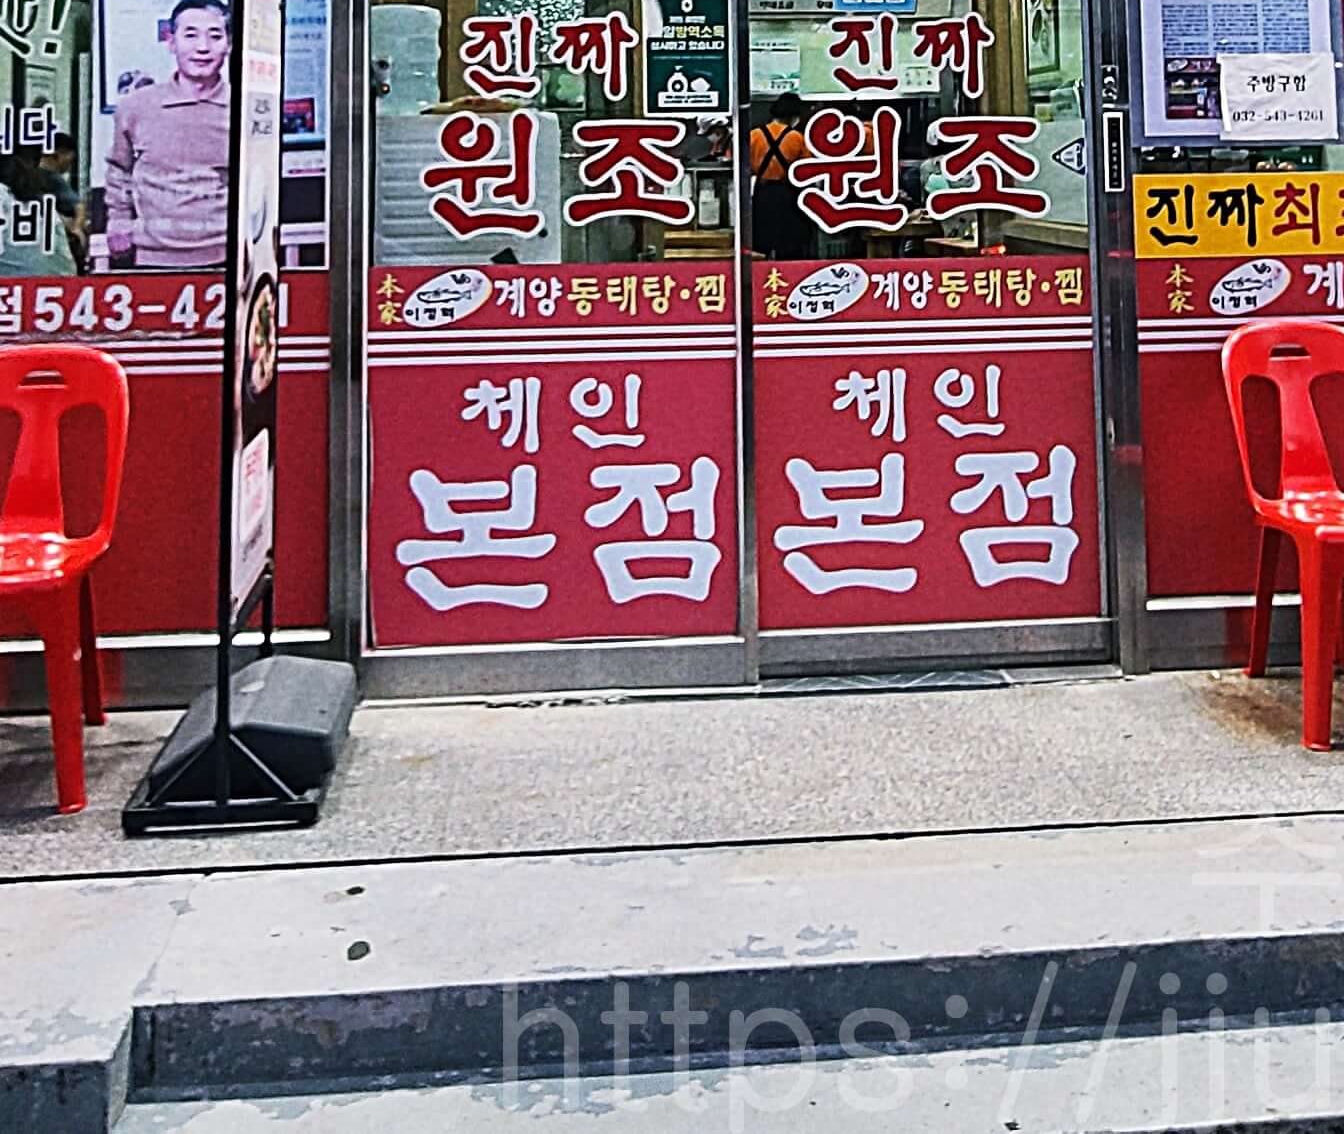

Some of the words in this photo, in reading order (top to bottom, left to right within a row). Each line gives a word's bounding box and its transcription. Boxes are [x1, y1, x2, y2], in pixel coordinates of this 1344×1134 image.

[462, 12, 640, 102] 진짜
[828, 11, 996, 100] 진짜
[1246, 74, 1308, 93] 주방구함
[419, 110, 696, 239] 원조
[788, 105, 1051, 235] 원조
[494, 276, 563, 318] 계양
[870, 269, 935, 311] 계양
[461, 372, 646, 454] 체인
[833, 364, 1008, 442] 체인
[395, 455, 723, 613] 본점
[773, 443, 1080, 597] 본점
